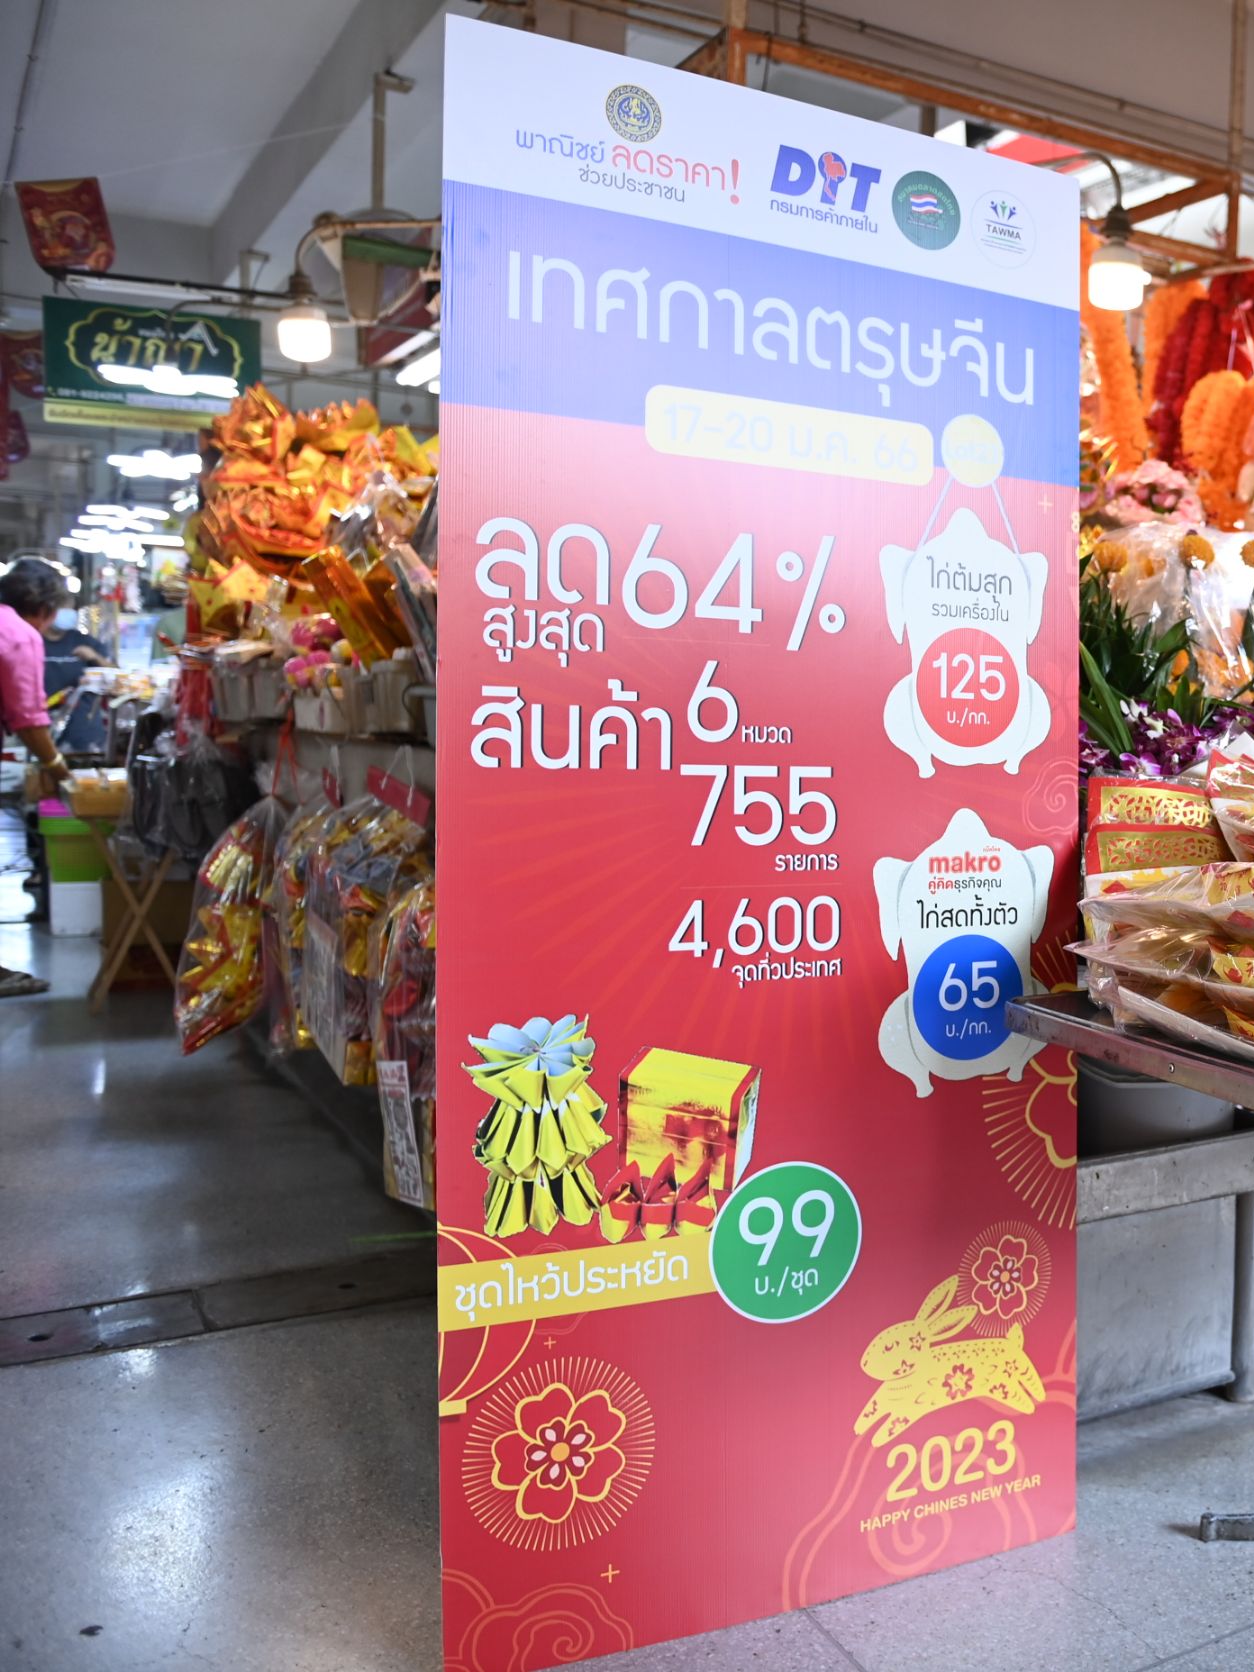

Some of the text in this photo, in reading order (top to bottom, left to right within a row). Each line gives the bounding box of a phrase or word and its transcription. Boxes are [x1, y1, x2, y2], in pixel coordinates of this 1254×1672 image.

[515, 128, 740, 205] พาณิชย์ ลดราคา!
[578, 164, 686, 203] ช่วยประชาชน
[769, 198, 879, 234] กรมการค้าภายใน
[985, 223, 1022, 241] TAWMA
[506, 249, 1036, 408] เทศกาลตรุษจีน
[872, 432, 920, 472] 66
[474, 516, 847, 652] ลด 64%
[926, 555, 1012, 598] ไก่ต้มสุก
[931, 597, 1009, 622] รวมเครื่องใน
[482, 606, 605, 668] สูงสุด
[932, 652, 1007, 702] 125
[470, 659, 793, 771] สินค้า 6 หมวด
[679, 764, 837, 848] 755
[774, 852, 839, 873] รายการ
[928, 851, 1002, 874] makro
[928, 876, 1002, 895] คู่คิดธุรกิจคุณ
[668, 895, 841, 969] 4,600
[916, 894, 1018, 929] ไก่สดทั้งตัว
[937, 960, 1000, 1012] 65
[738, 1189, 836, 1267] 99
[886, 1419, 1016, 1502] 2023
[860, 1473, 1042, 1533] HAPPY CHINES NEW YEAR
